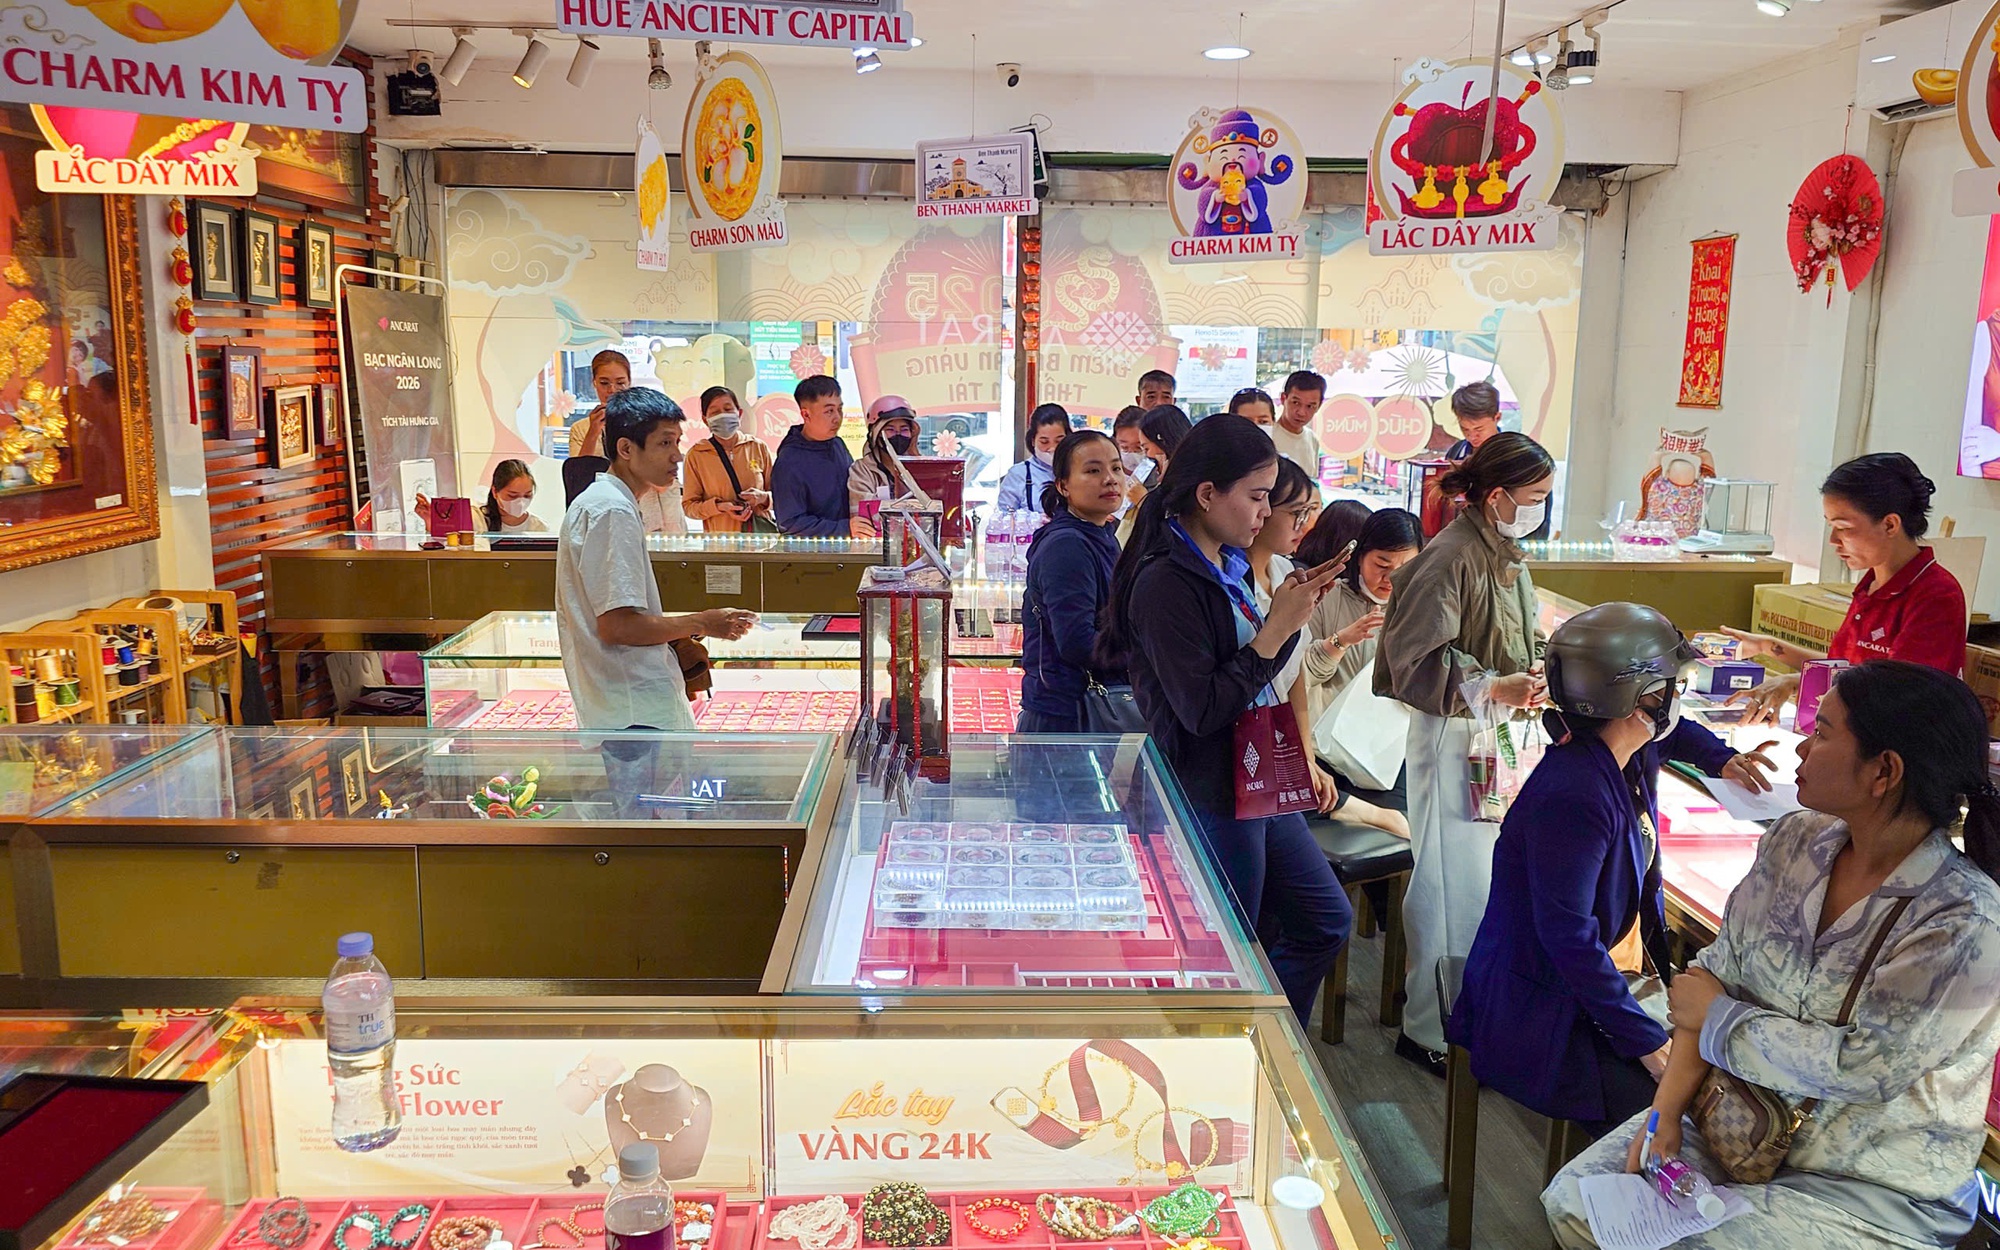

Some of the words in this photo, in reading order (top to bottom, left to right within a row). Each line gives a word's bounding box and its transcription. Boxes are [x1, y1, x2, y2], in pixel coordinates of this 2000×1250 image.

[563, 0, 632, 29] HUE
[641, 1, 776, 38] ANCIENT
[787, 9, 908, 44] CAPITAL
[2, 47, 187, 99] CHARM
[201, 67, 287, 110] KIM
[297, 76, 349, 125] TỴ
[53, 146, 107, 185] LẮC
[116, 154, 175, 186] DÂY
[184, 163, 240, 188] MIX
[917, 204, 938, 217] BEN
[942, 201, 982, 216] THANH
[986, 199, 1032, 214] MARKET
[690, 227, 729, 248] CHARM
[730, 223, 754, 244] SƠN
[757, 216, 785, 241] MÀU
[1382, 216, 1425, 248] LẮC
[1432, 219, 1481, 247] DÂY
[1487, 222, 1536, 245] MIX
[1171, 238, 1233, 257] CHARM
[1239, 236, 1272, 253] KIM
[1277, 234, 1299, 257] TỴ
[1699, 261, 1722, 282] Khai
[1694, 304, 1719, 326] Hồng
[390, 320, 419, 333] ANCARAT
[1693, 325, 1716, 345] Phát
[364, 352, 386, 371] BẠC
[387, 352, 415, 369] NGÂN
[416, 356, 442, 370] LONG
[396, 375, 421, 390] 2026
[381, 414, 398, 427] TÍCH
[398, 414, 409, 427] TÀI
[429, 416, 439, 426] GIA
[358, 1012, 374, 1024] TH
[358, 1019, 385, 1035] true
[410, 1063, 461, 1086] Sức
[401, 1092, 504, 1117] Flower
[833, 1080, 899, 1119] Lắc
[903, 1088, 956, 1126] tay
[799, 1125, 909, 1161] VÀNG
[918, 1132, 992, 1160] 24K
